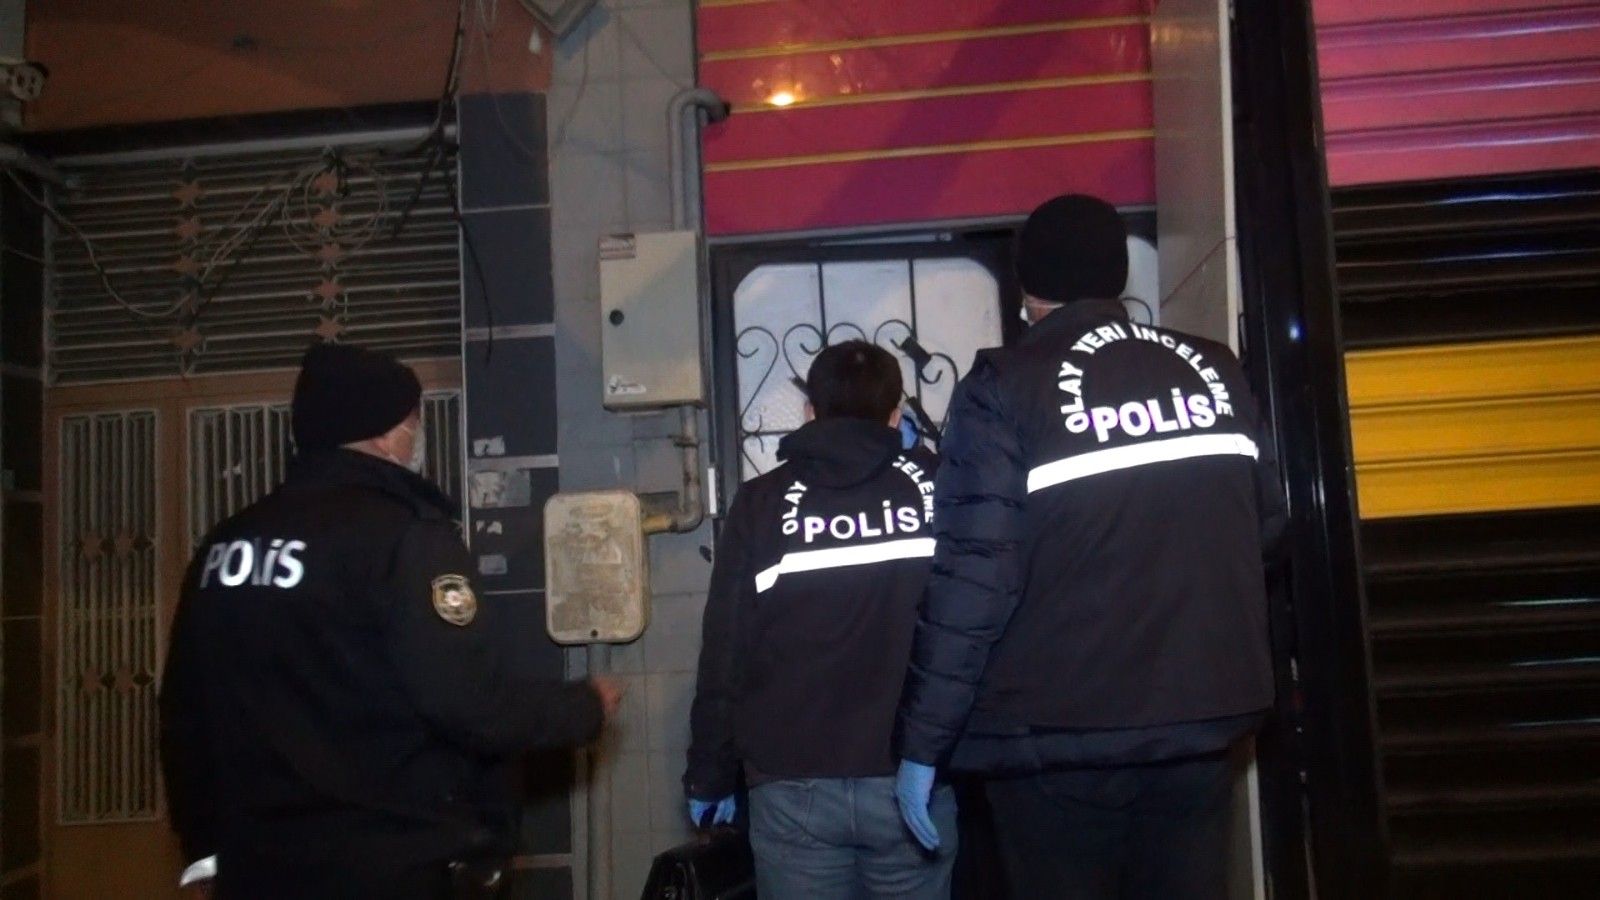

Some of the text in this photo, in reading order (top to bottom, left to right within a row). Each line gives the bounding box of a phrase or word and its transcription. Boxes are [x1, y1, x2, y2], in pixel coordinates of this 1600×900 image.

[1058, 361, 1089, 433] OLAY
[1091, 387, 1216, 443] POLİS
[782, 481, 807, 535] OLAY
[804, 500, 920, 543] POLİS
[200, 537, 307, 589] POLİS
